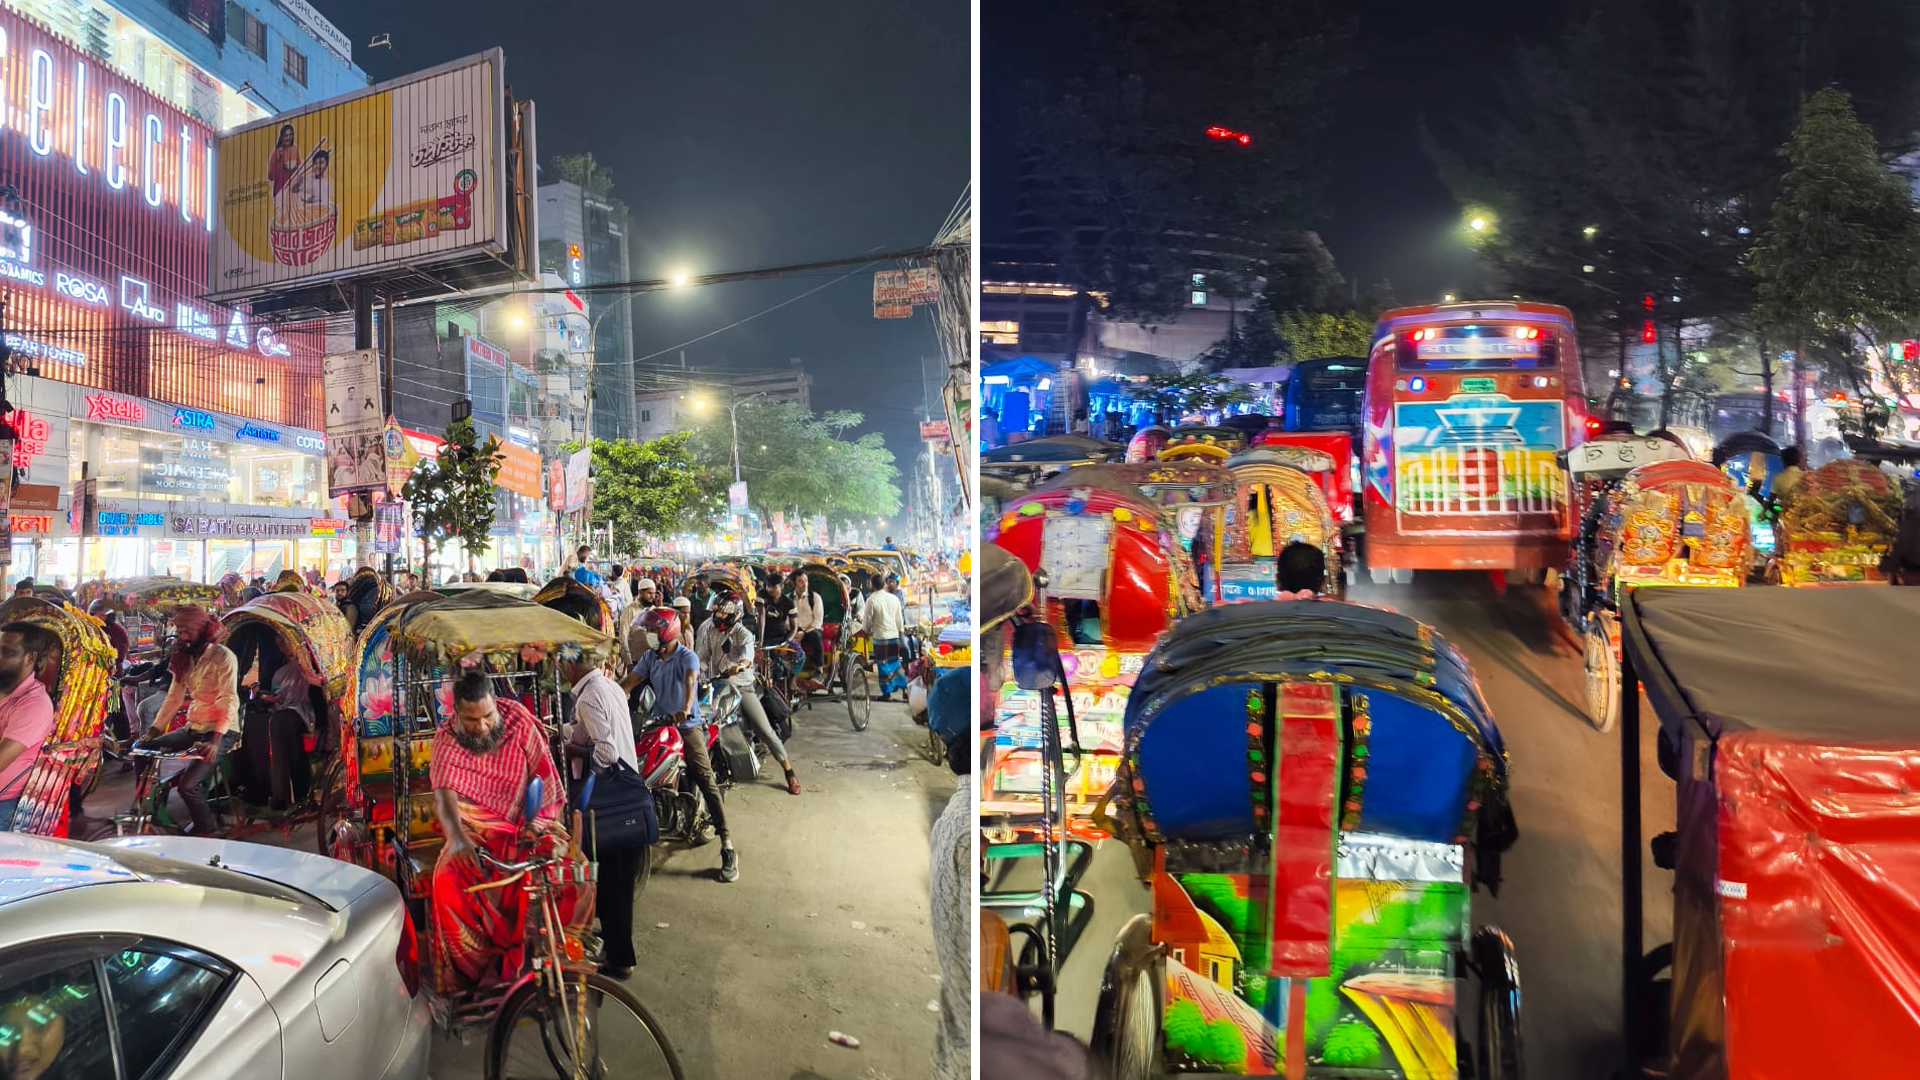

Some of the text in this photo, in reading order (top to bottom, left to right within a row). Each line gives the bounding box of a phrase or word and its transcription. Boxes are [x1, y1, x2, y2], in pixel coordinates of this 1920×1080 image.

[314, 15, 351, 52] CERAMIC
[56, 273, 109, 306] ROSA
[101, 396, 145, 422] Stella
[173, 408, 214, 430] ASTRA
[296, 435, 325, 451] COTTO
[173, 517, 195, 534] SA
[197, 517, 234, 534] BATH
